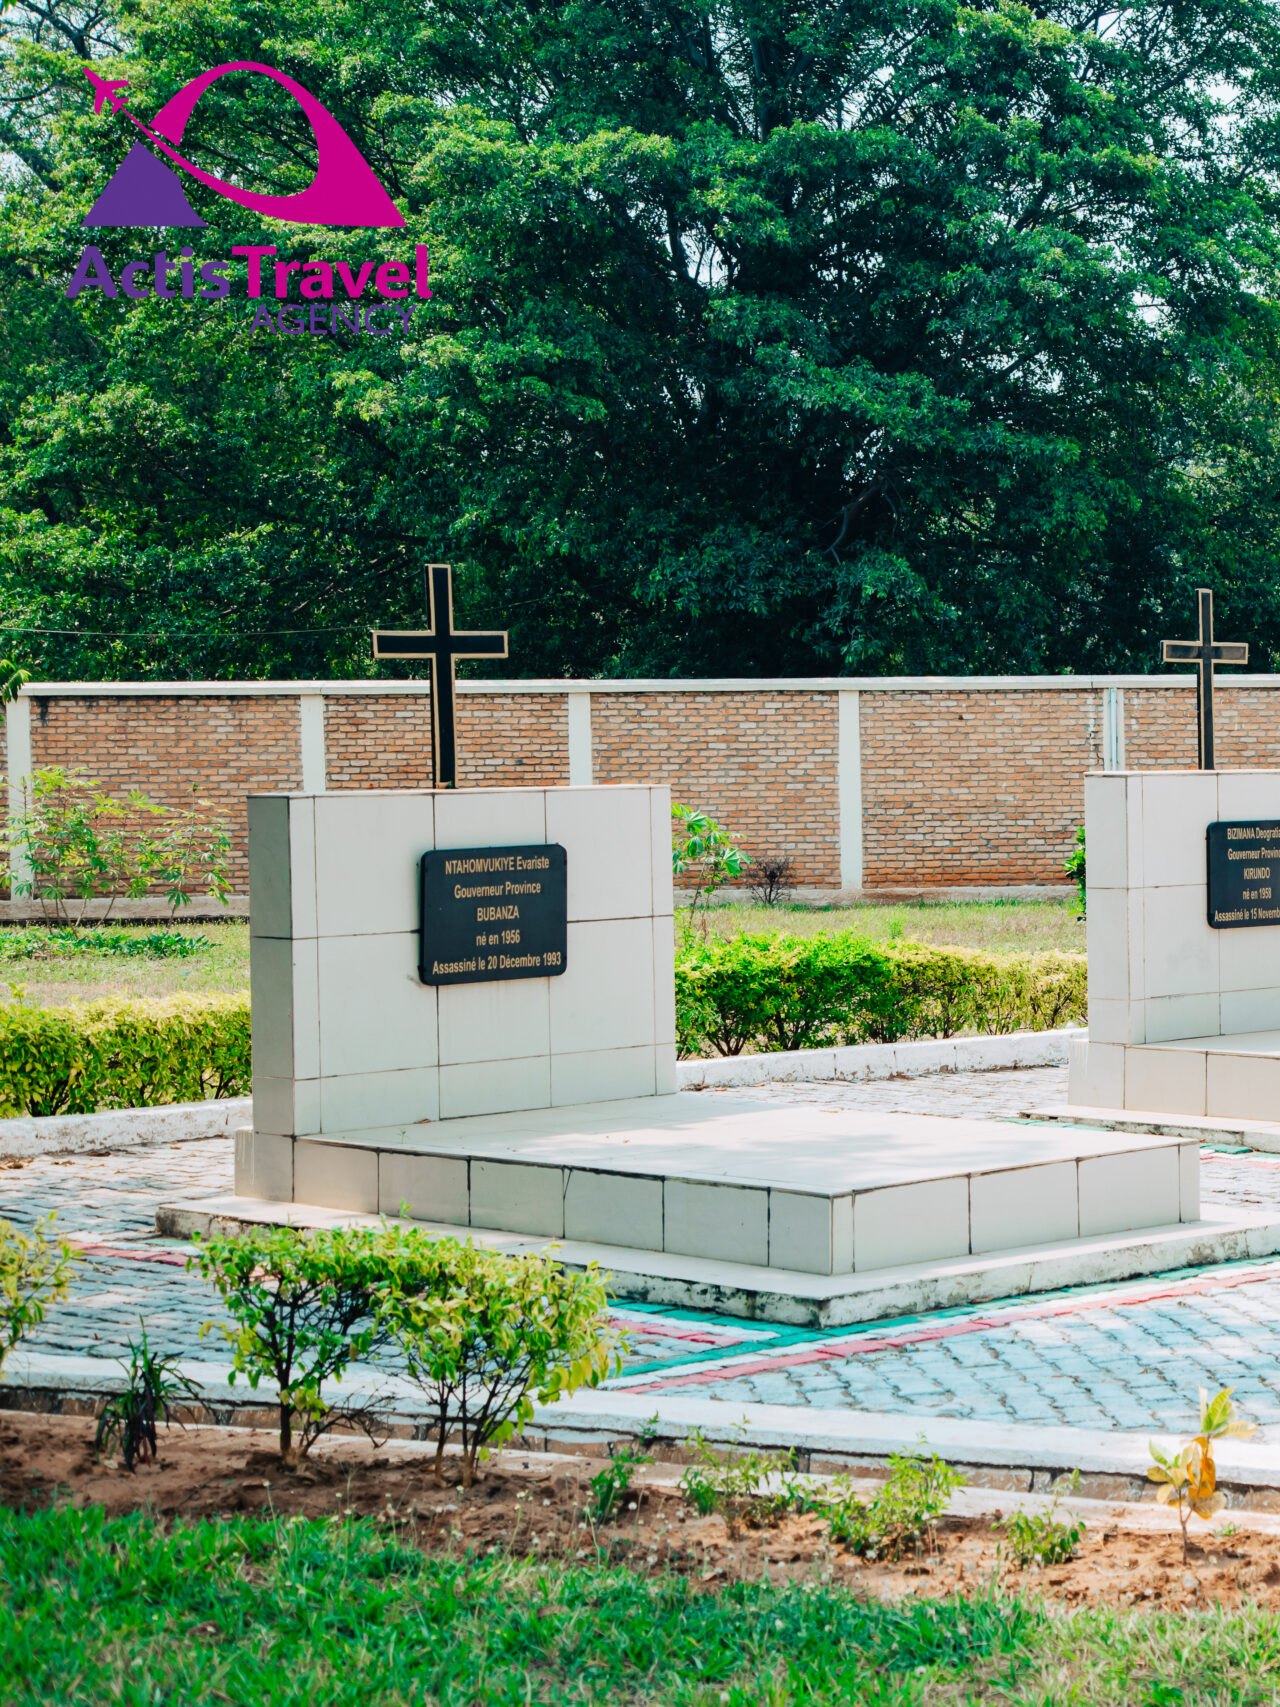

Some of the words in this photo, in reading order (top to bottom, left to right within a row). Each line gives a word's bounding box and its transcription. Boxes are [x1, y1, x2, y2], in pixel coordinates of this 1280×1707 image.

[1227, 827, 1255, 840] BIZIMANA
[1227, 848, 1260, 860] Gouverneur
[445, 856, 514, 875] NTAHOMVUKIYE
[516, 855, 550, 871] Evariste
[1243, 867, 1271, 880] KIRUNDO
[454, 884, 504, 899] Gouverneur
[505, 880, 542, 895] Province
[1251, 891, 1258, 900] en
[476, 905, 520, 922] BUBANZA
[1214, 908, 1243, 922] Assassiné
[1244, 908, 1250, 920] le
[1250, 907, 1257, 919] 15
[476, 931, 487, 946] né
[488, 934, 499, 945] en
[501, 929, 521, 944] 1956
[432, 956, 477, 975] Assassiné
[478, 956, 486, 970] le
[487, 955, 498, 970] 20
[499, 953, 541, 969] Décembre
[542, 951, 562, 966] 1993
